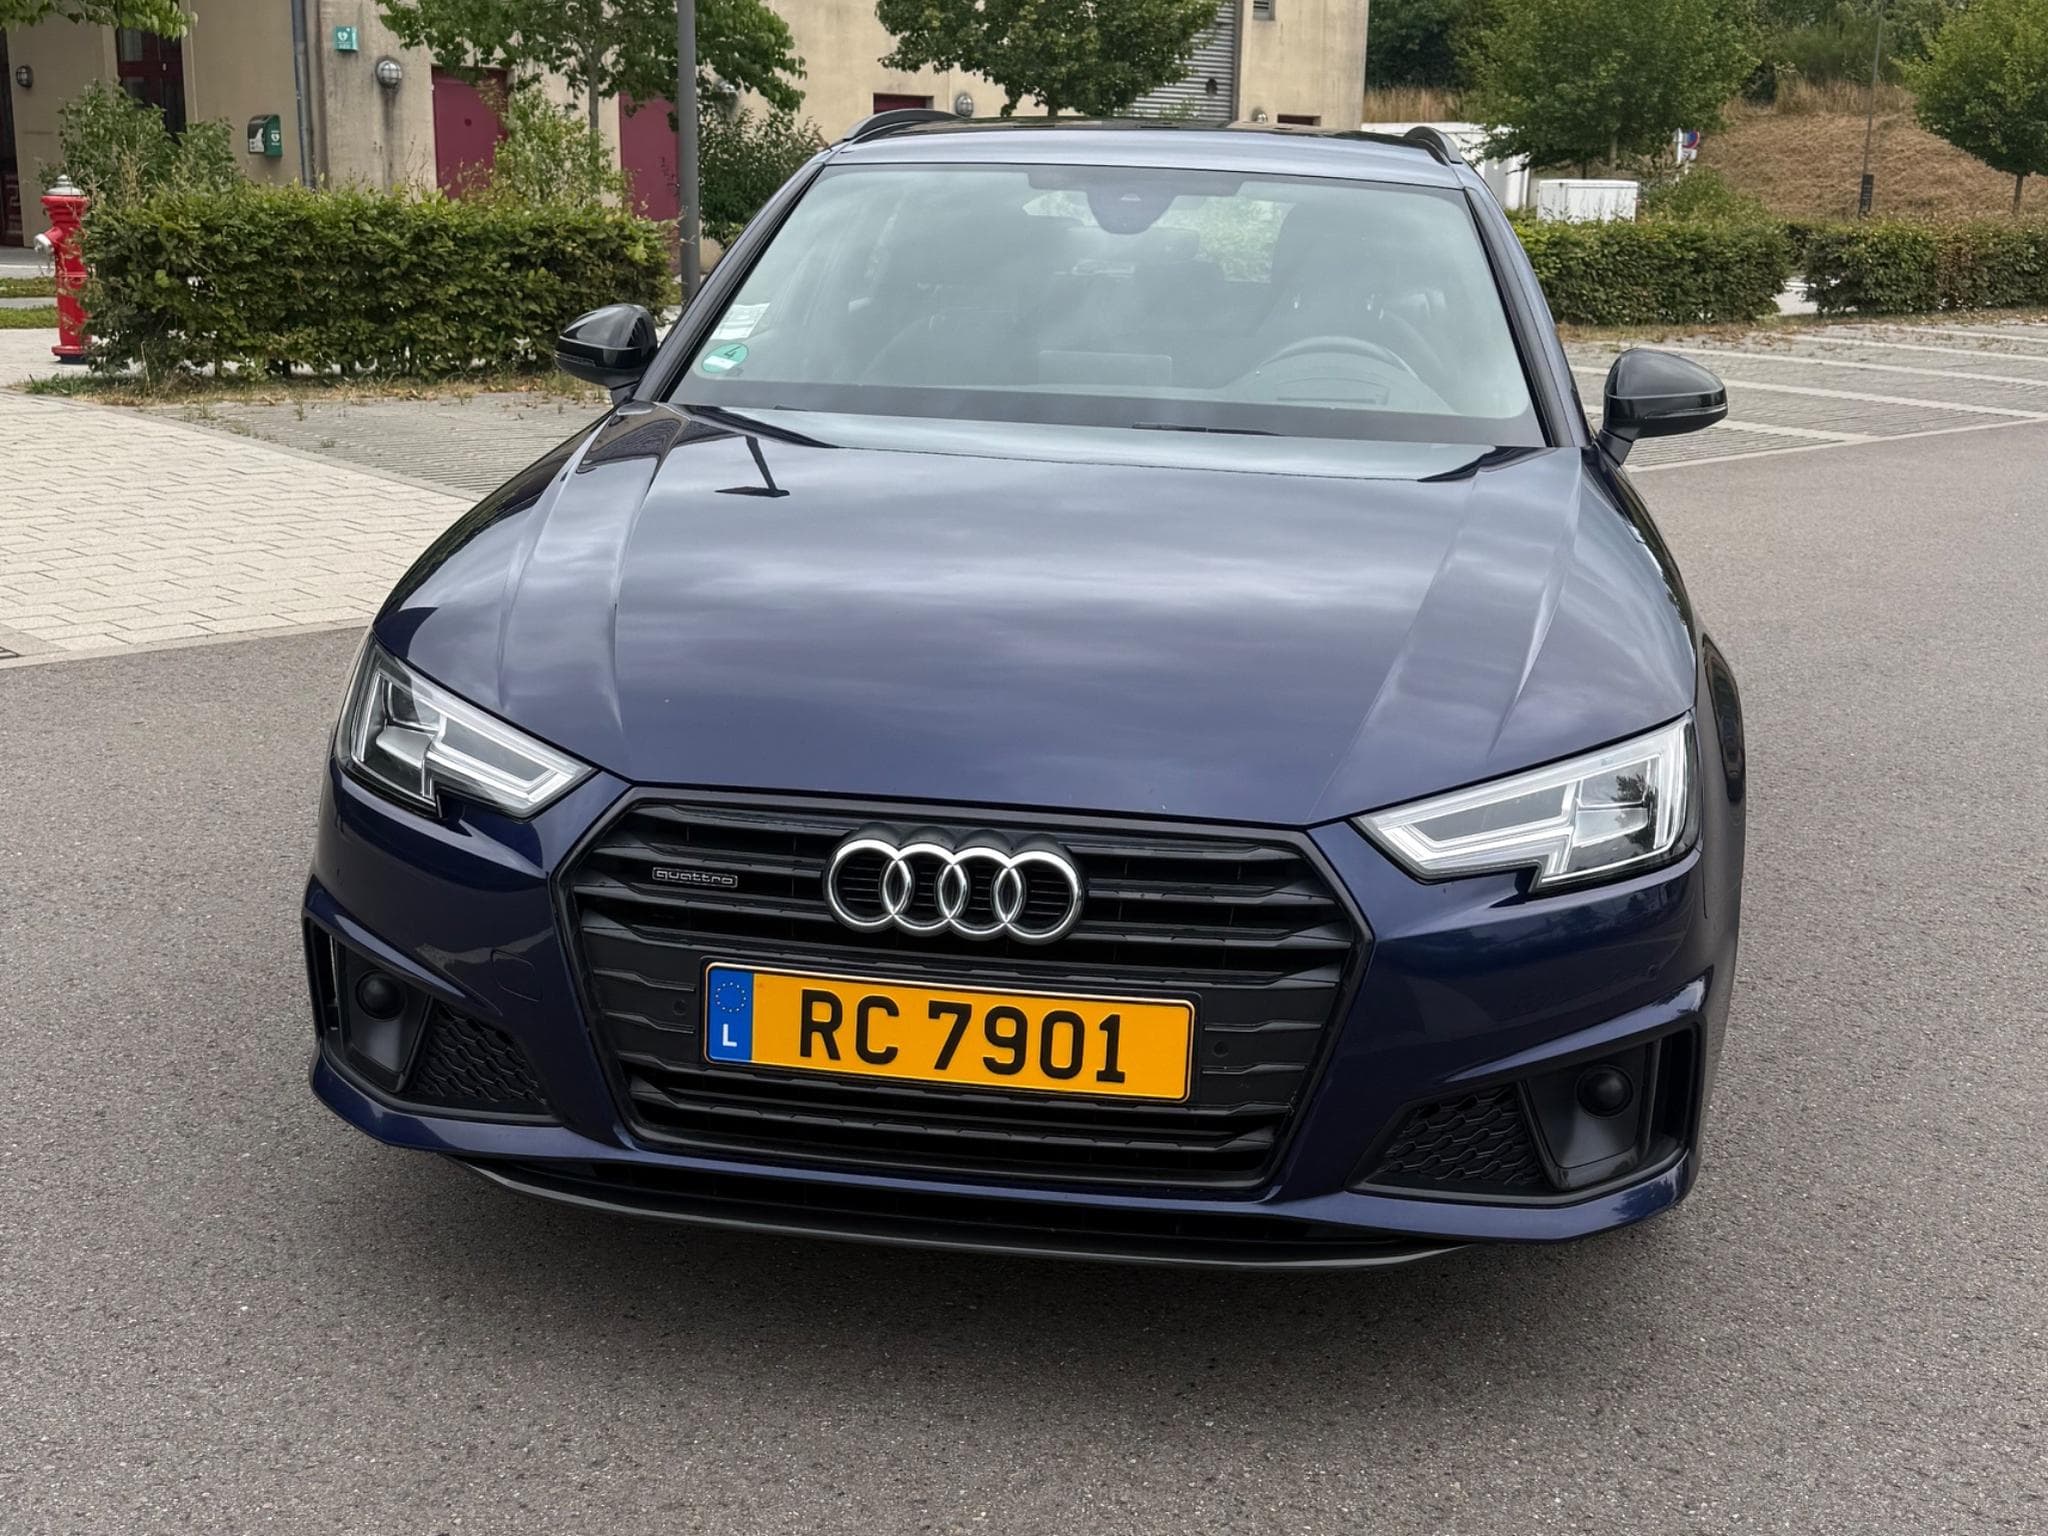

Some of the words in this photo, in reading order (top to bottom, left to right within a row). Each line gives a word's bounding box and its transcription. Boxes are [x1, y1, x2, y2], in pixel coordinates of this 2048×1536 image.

[723, 346, 741, 359] 4
[655, 869, 734, 885] quattro
[722, 1023, 738, 1047] L
[800, 989, 900, 1066] RC
[928, 1000, 1126, 1083] 7901
